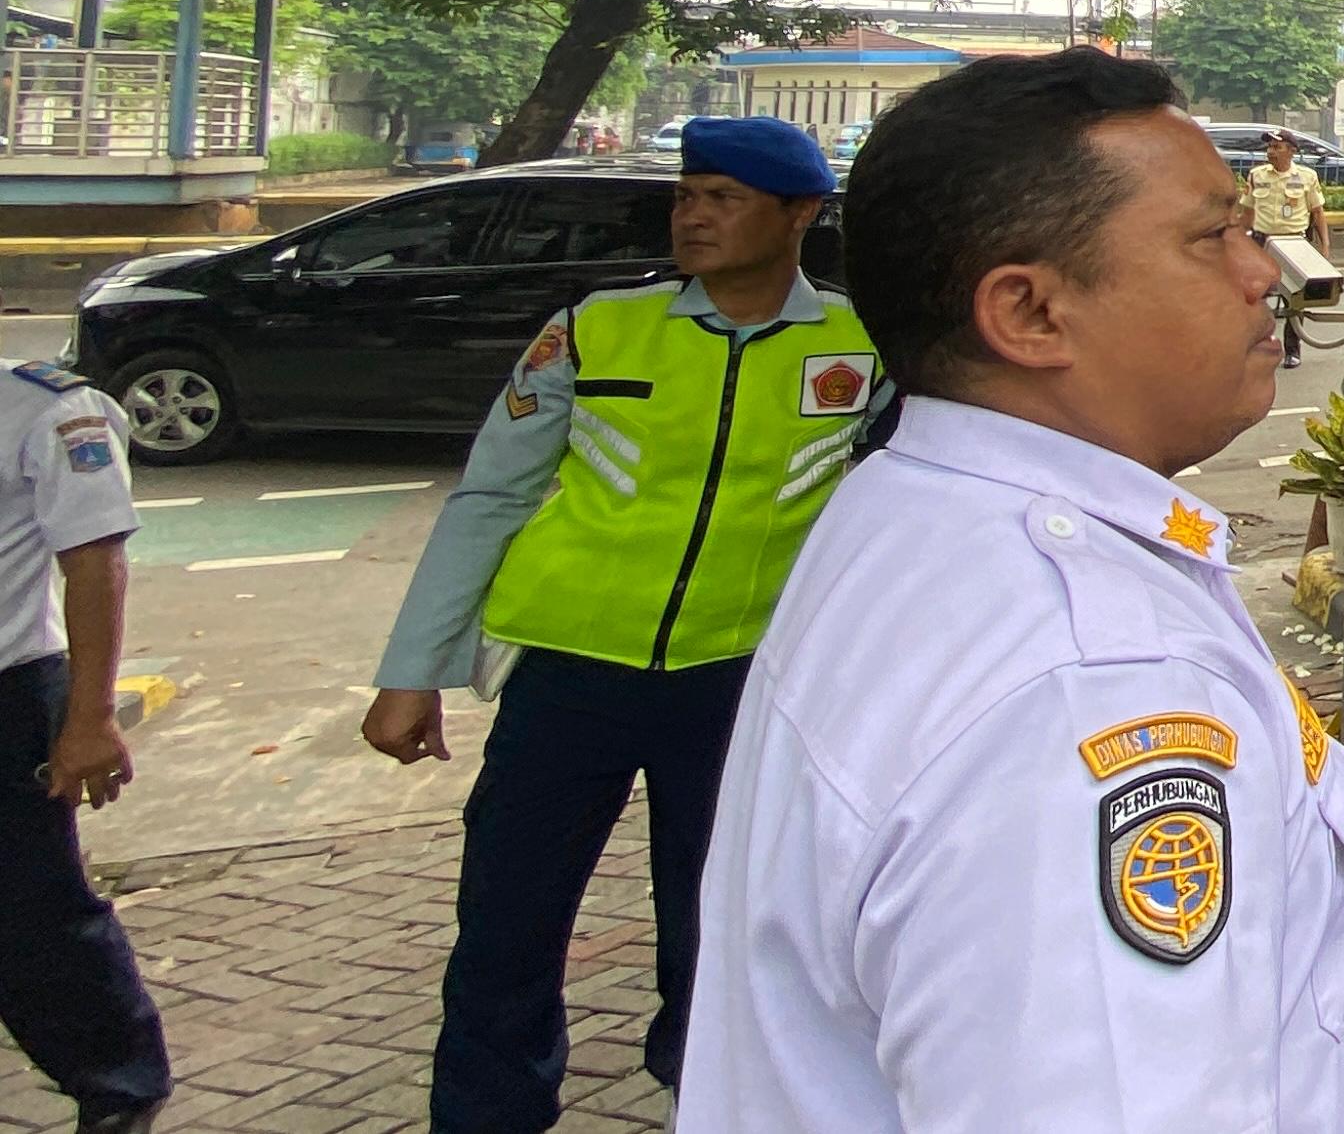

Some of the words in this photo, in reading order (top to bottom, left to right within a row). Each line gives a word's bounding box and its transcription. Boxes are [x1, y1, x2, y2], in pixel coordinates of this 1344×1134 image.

[1095, 729, 1143, 766] DINAS
[1147, 722, 1230, 760] PERHUBUNGAN
[1112, 780, 1220, 823] PERHUBUNGAN
